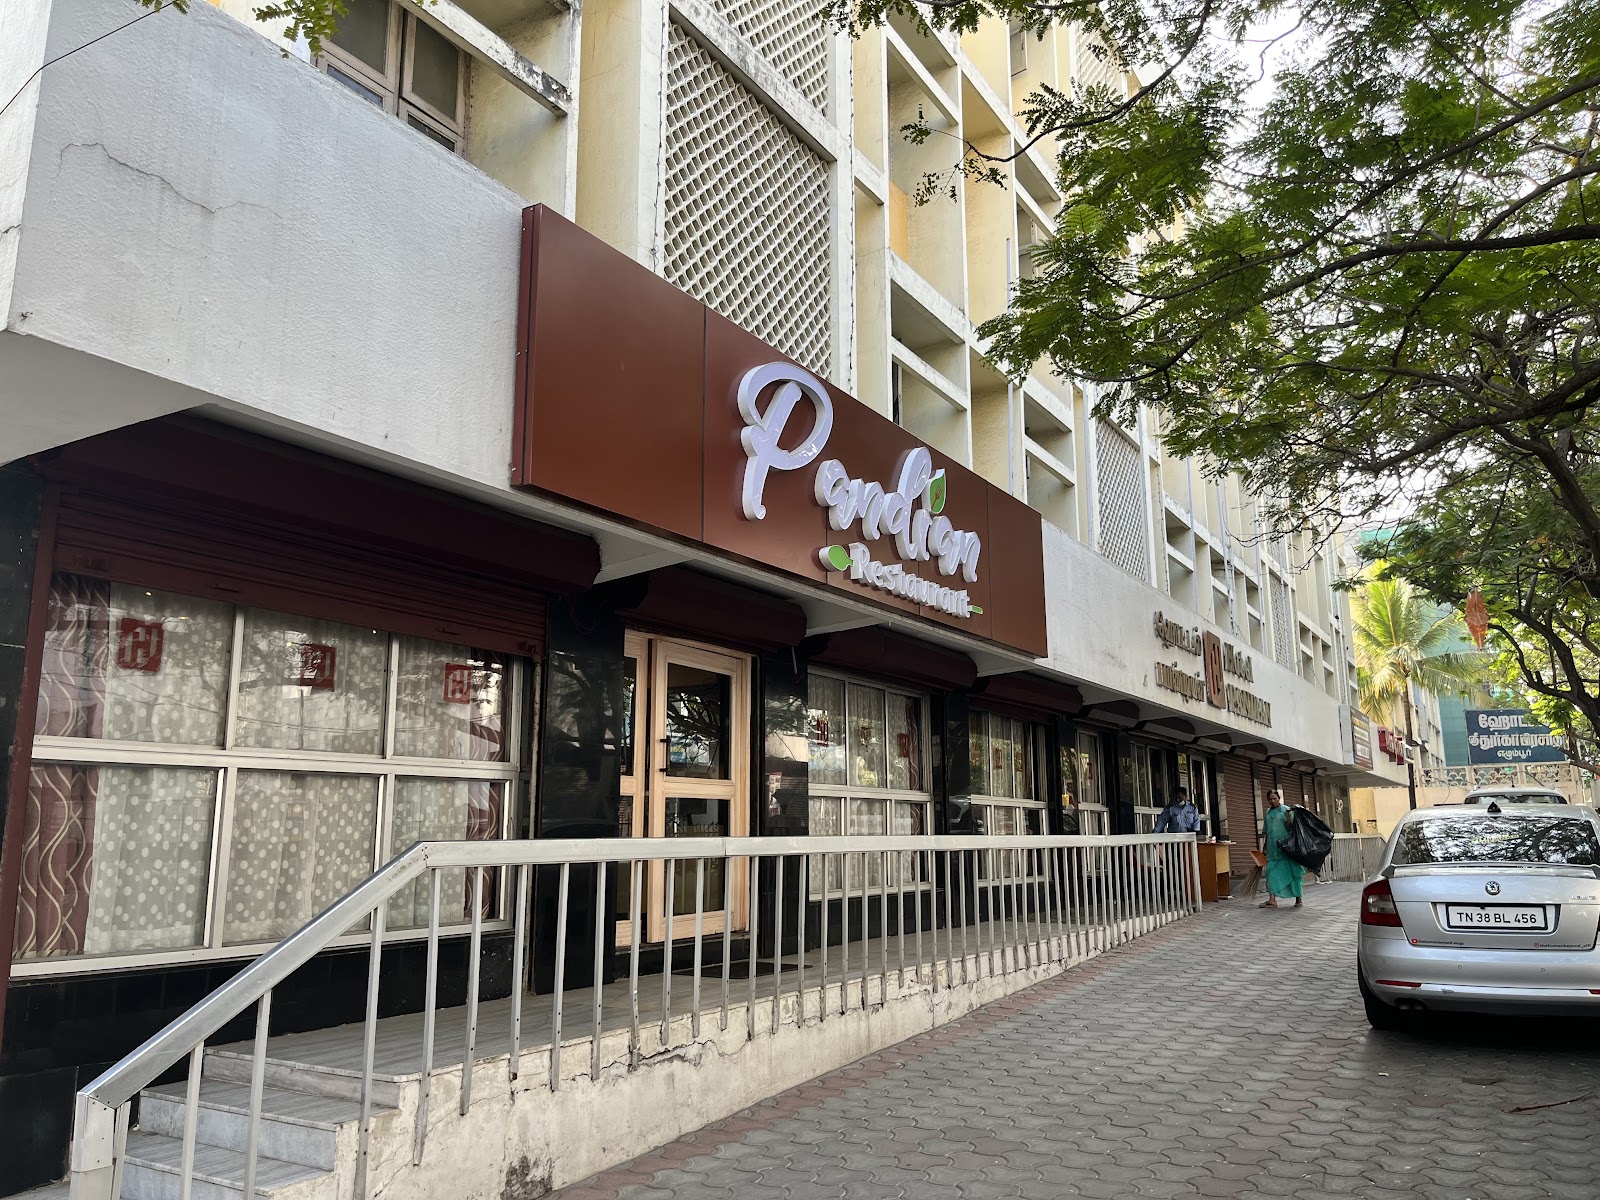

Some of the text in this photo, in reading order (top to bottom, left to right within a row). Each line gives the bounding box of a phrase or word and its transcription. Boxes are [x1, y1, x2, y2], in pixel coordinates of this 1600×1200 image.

[737, 361, 982, 583] Pandian
[849, 542, 971, 618] Restaurant
[1456, 912, 1537, 924] TN 38 BL 456
